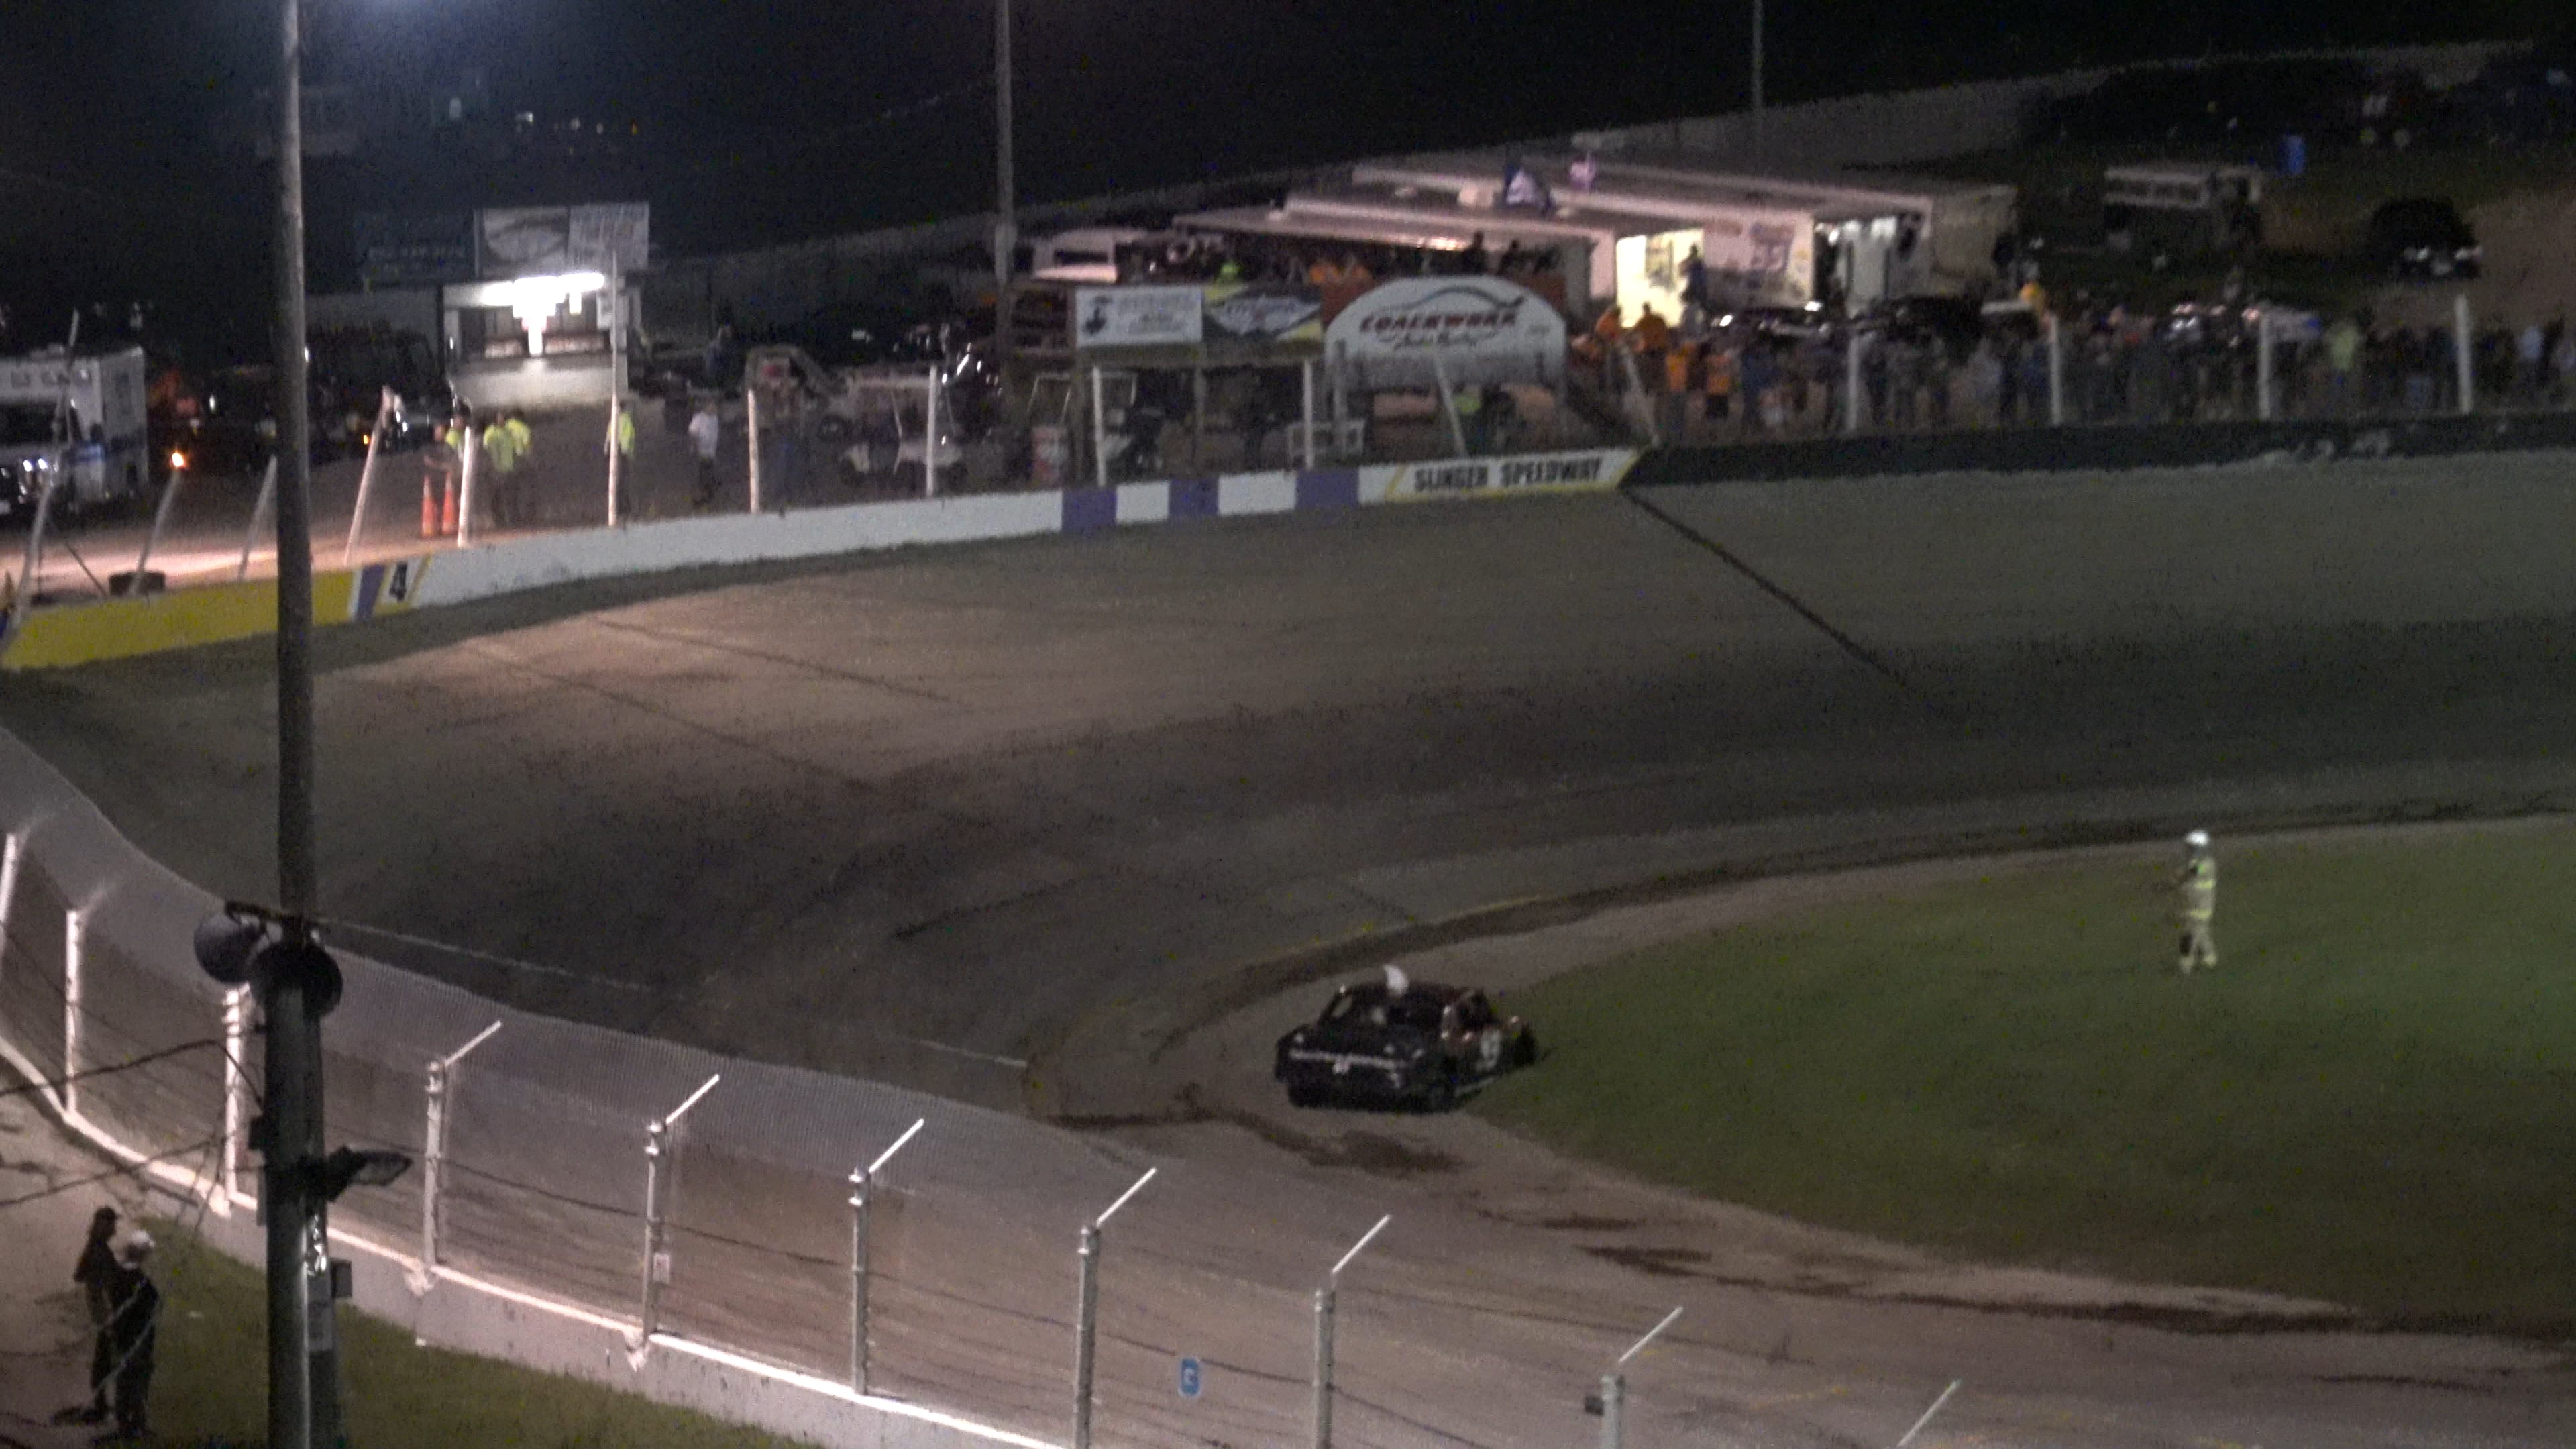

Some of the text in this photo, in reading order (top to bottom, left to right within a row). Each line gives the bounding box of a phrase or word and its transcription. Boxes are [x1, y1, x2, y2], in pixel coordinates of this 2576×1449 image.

[1414, 458, 1603, 490] SLINGER SPEEDWAY
[389, 562, 408, 601] 4
